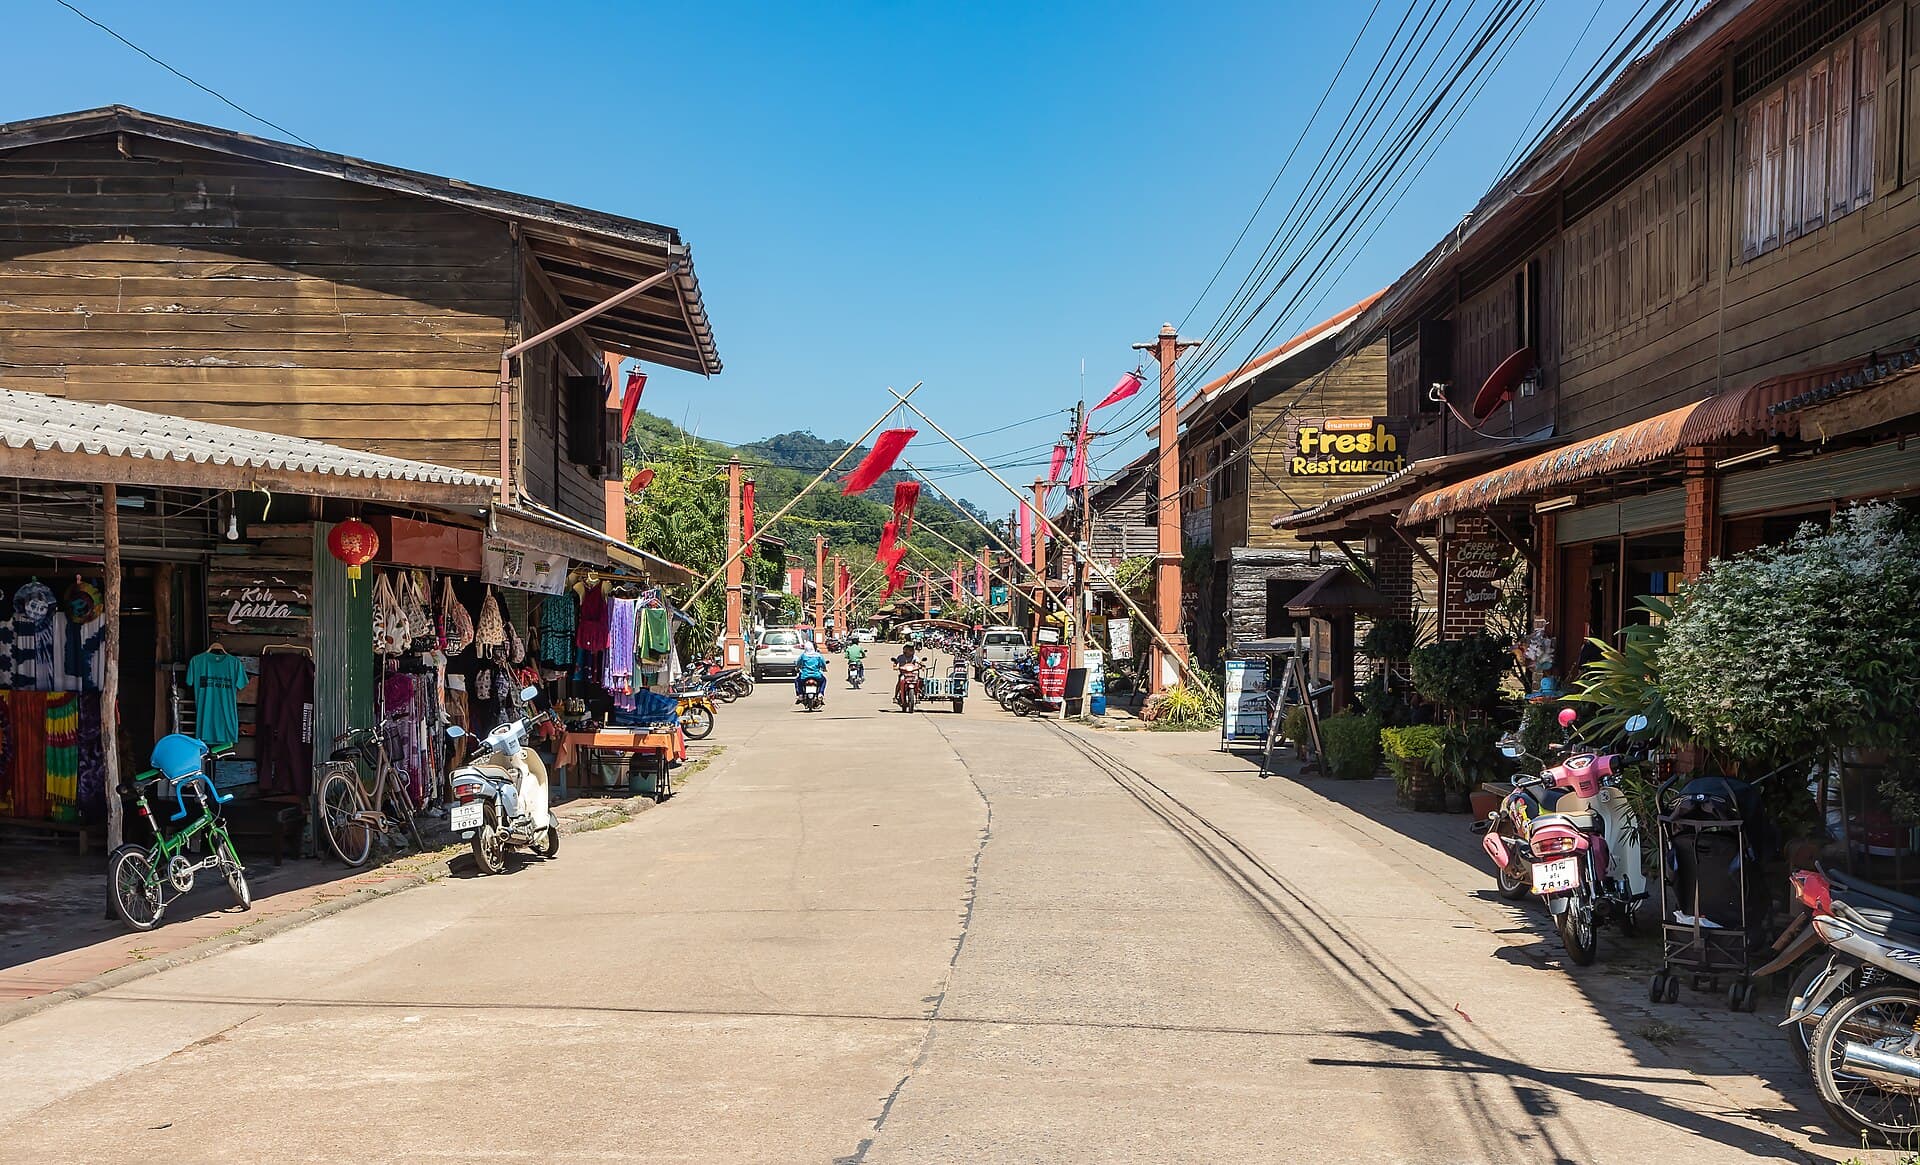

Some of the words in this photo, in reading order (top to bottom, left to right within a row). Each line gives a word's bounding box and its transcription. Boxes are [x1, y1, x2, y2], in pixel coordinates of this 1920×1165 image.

[1299, 424, 1397, 453] Fresh
[1292, 455, 1405, 475] Restaurant
[1457, 549, 1498, 560] Coffee
[1457, 565, 1498, 578] Cocktail
[241, 587, 274, 602] Koh
[1464, 588, 1497, 603] Seafood
[228, 600, 292, 625] Lanta
